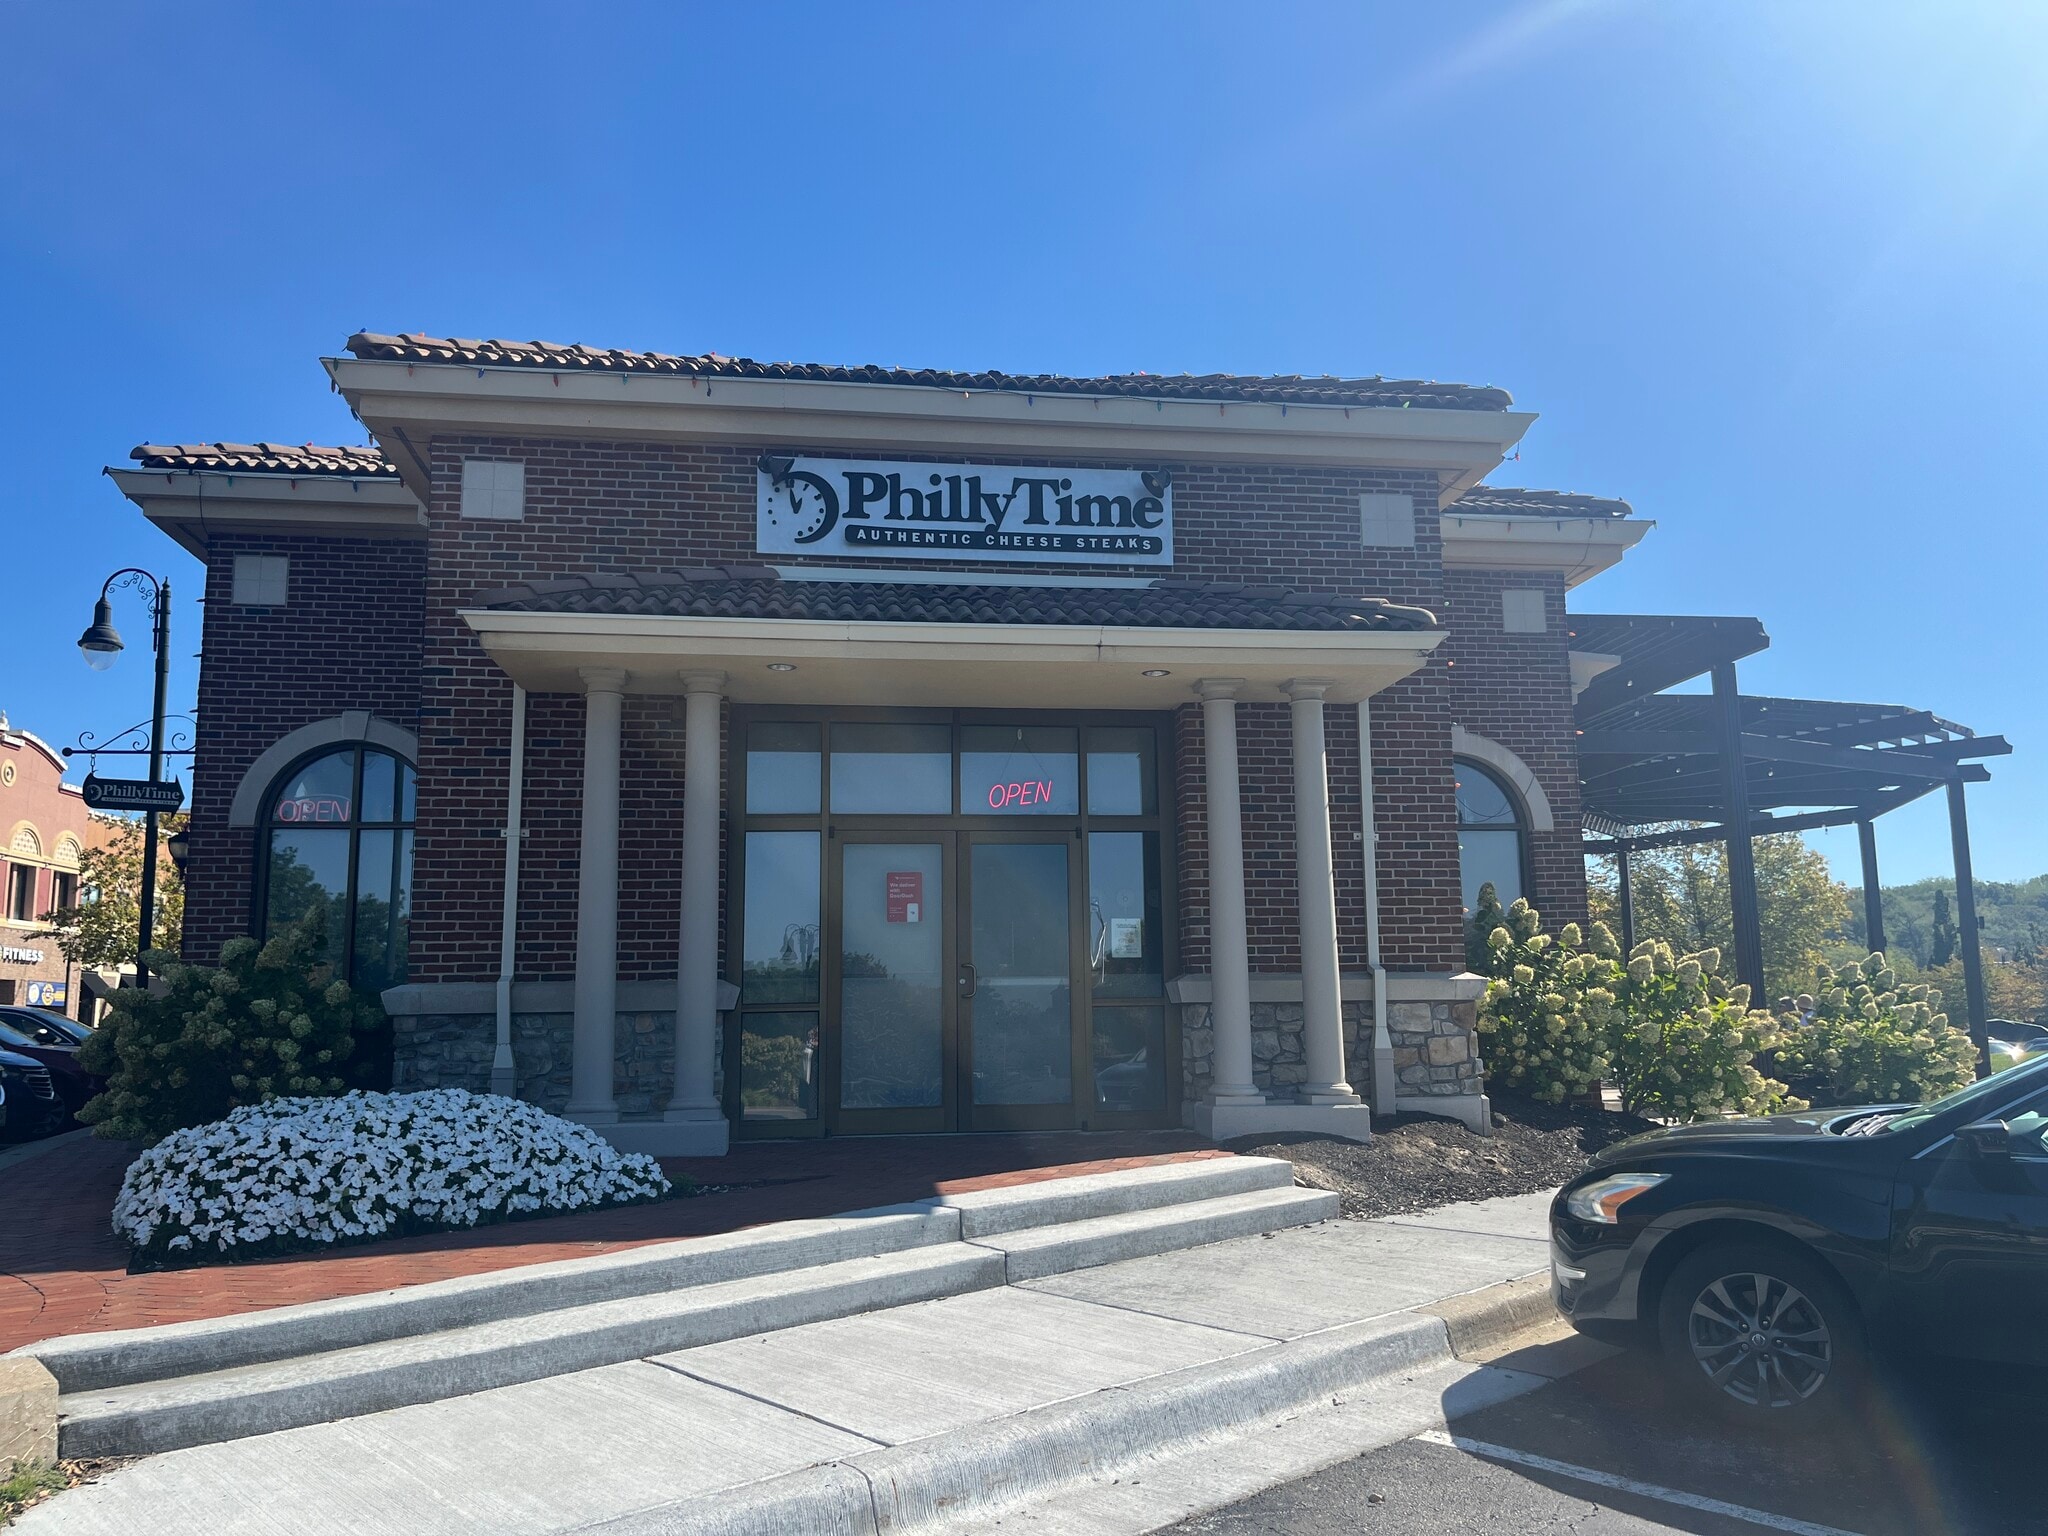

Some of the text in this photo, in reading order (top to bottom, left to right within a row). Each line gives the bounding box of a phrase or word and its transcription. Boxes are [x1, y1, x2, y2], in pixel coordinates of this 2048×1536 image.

[842, 471, 1164, 532] PhillyTime
[856, 528, 1151, 550] AUTHENTIC CHEESE STEAKS
[102, 784, 180, 800] PhillyTime
[988, 780, 1052, 808] OPEN
[279, 800, 350, 822] OPEN
[3, 946, 44, 963] FITNESS
